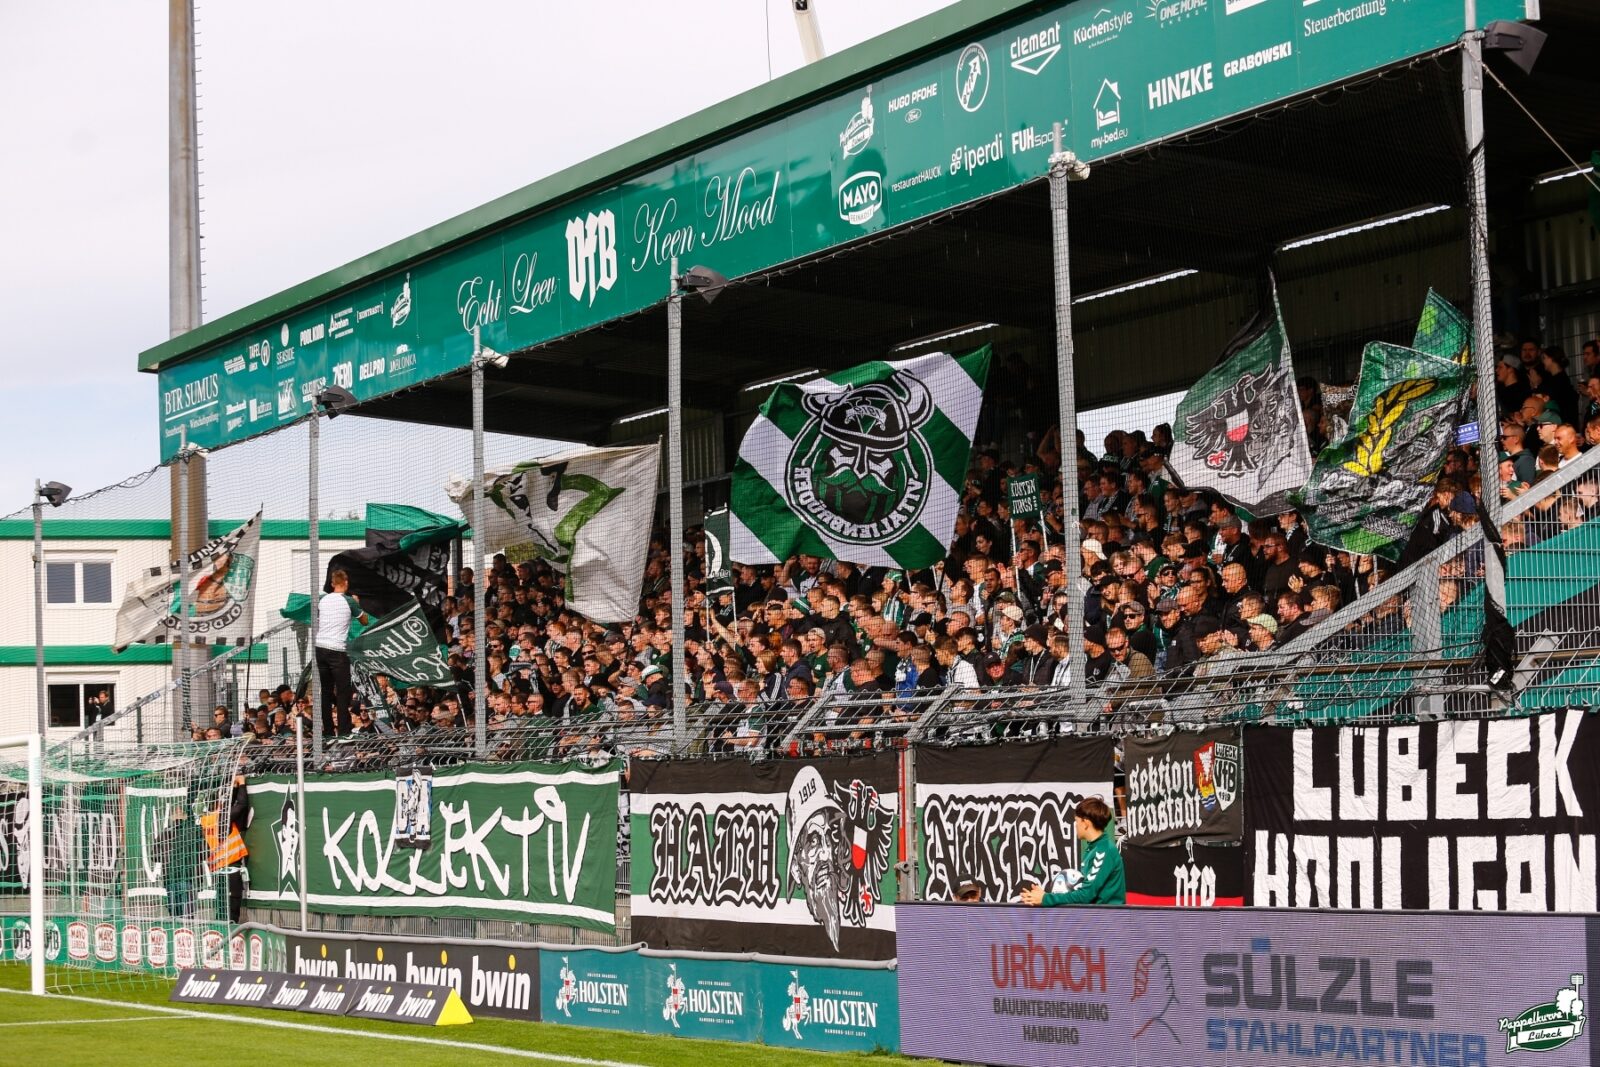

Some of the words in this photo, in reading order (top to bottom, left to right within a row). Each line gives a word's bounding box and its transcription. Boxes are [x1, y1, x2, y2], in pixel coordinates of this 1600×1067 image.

[1073, 10, 1133, 45] Küchenstyle
[1304, 0, 1387, 37] Steuerberatung
[1010, 20, 1061, 60] clement
[1223, 40, 1292, 78] GRABOWSKI
[888, 94, 910, 113] HUGO
[911, 82, 938, 105] PFOHE
[1148, 62, 1213, 110] HINZKE
[1091, 127, 1129, 149] my-bed.eu
[964, 132, 1004, 176] iperdi
[843, 180, 879, 210] MAYO
[565, 208, 618, 308] VfB
[631, 198, 696, 272] Keen
[701, 166, 780, 247] Mood
[164, 387, 184, 416] BTR
[185, 373, 219, 408] SUMUS
[1214, 760, 1237, 792] VfB
[1293, 709, 1584, 821] LÜBECK
[798, 778, 817, 805] 1919
[180, 973, 220, 998] bwin
[225, 976, 267, 1002] bwin
[471, 954, 531, 1010] bwin
[578, 980, 629, 1007] HOLSTEN
[1203, 938, 1434, 1020] SÜLZLE
[273, 981, 309, 1008] bwin
[313, 984, 346, 1011] bwin
[356, 986, 395, 1014] bwin
[397, 990, 437, 1019] bwin
[688, 988, 744, 1016] HOLSTEN
[993, 997, 1109, 1022] BAUUNTERNEHMUNG
[813, 998, 878, 1028] HOLSTEN
[1022, 1024, 1079, 1045] HAMBURG
[1205, 1017, 1488, 1067] STAHLPARTNER
